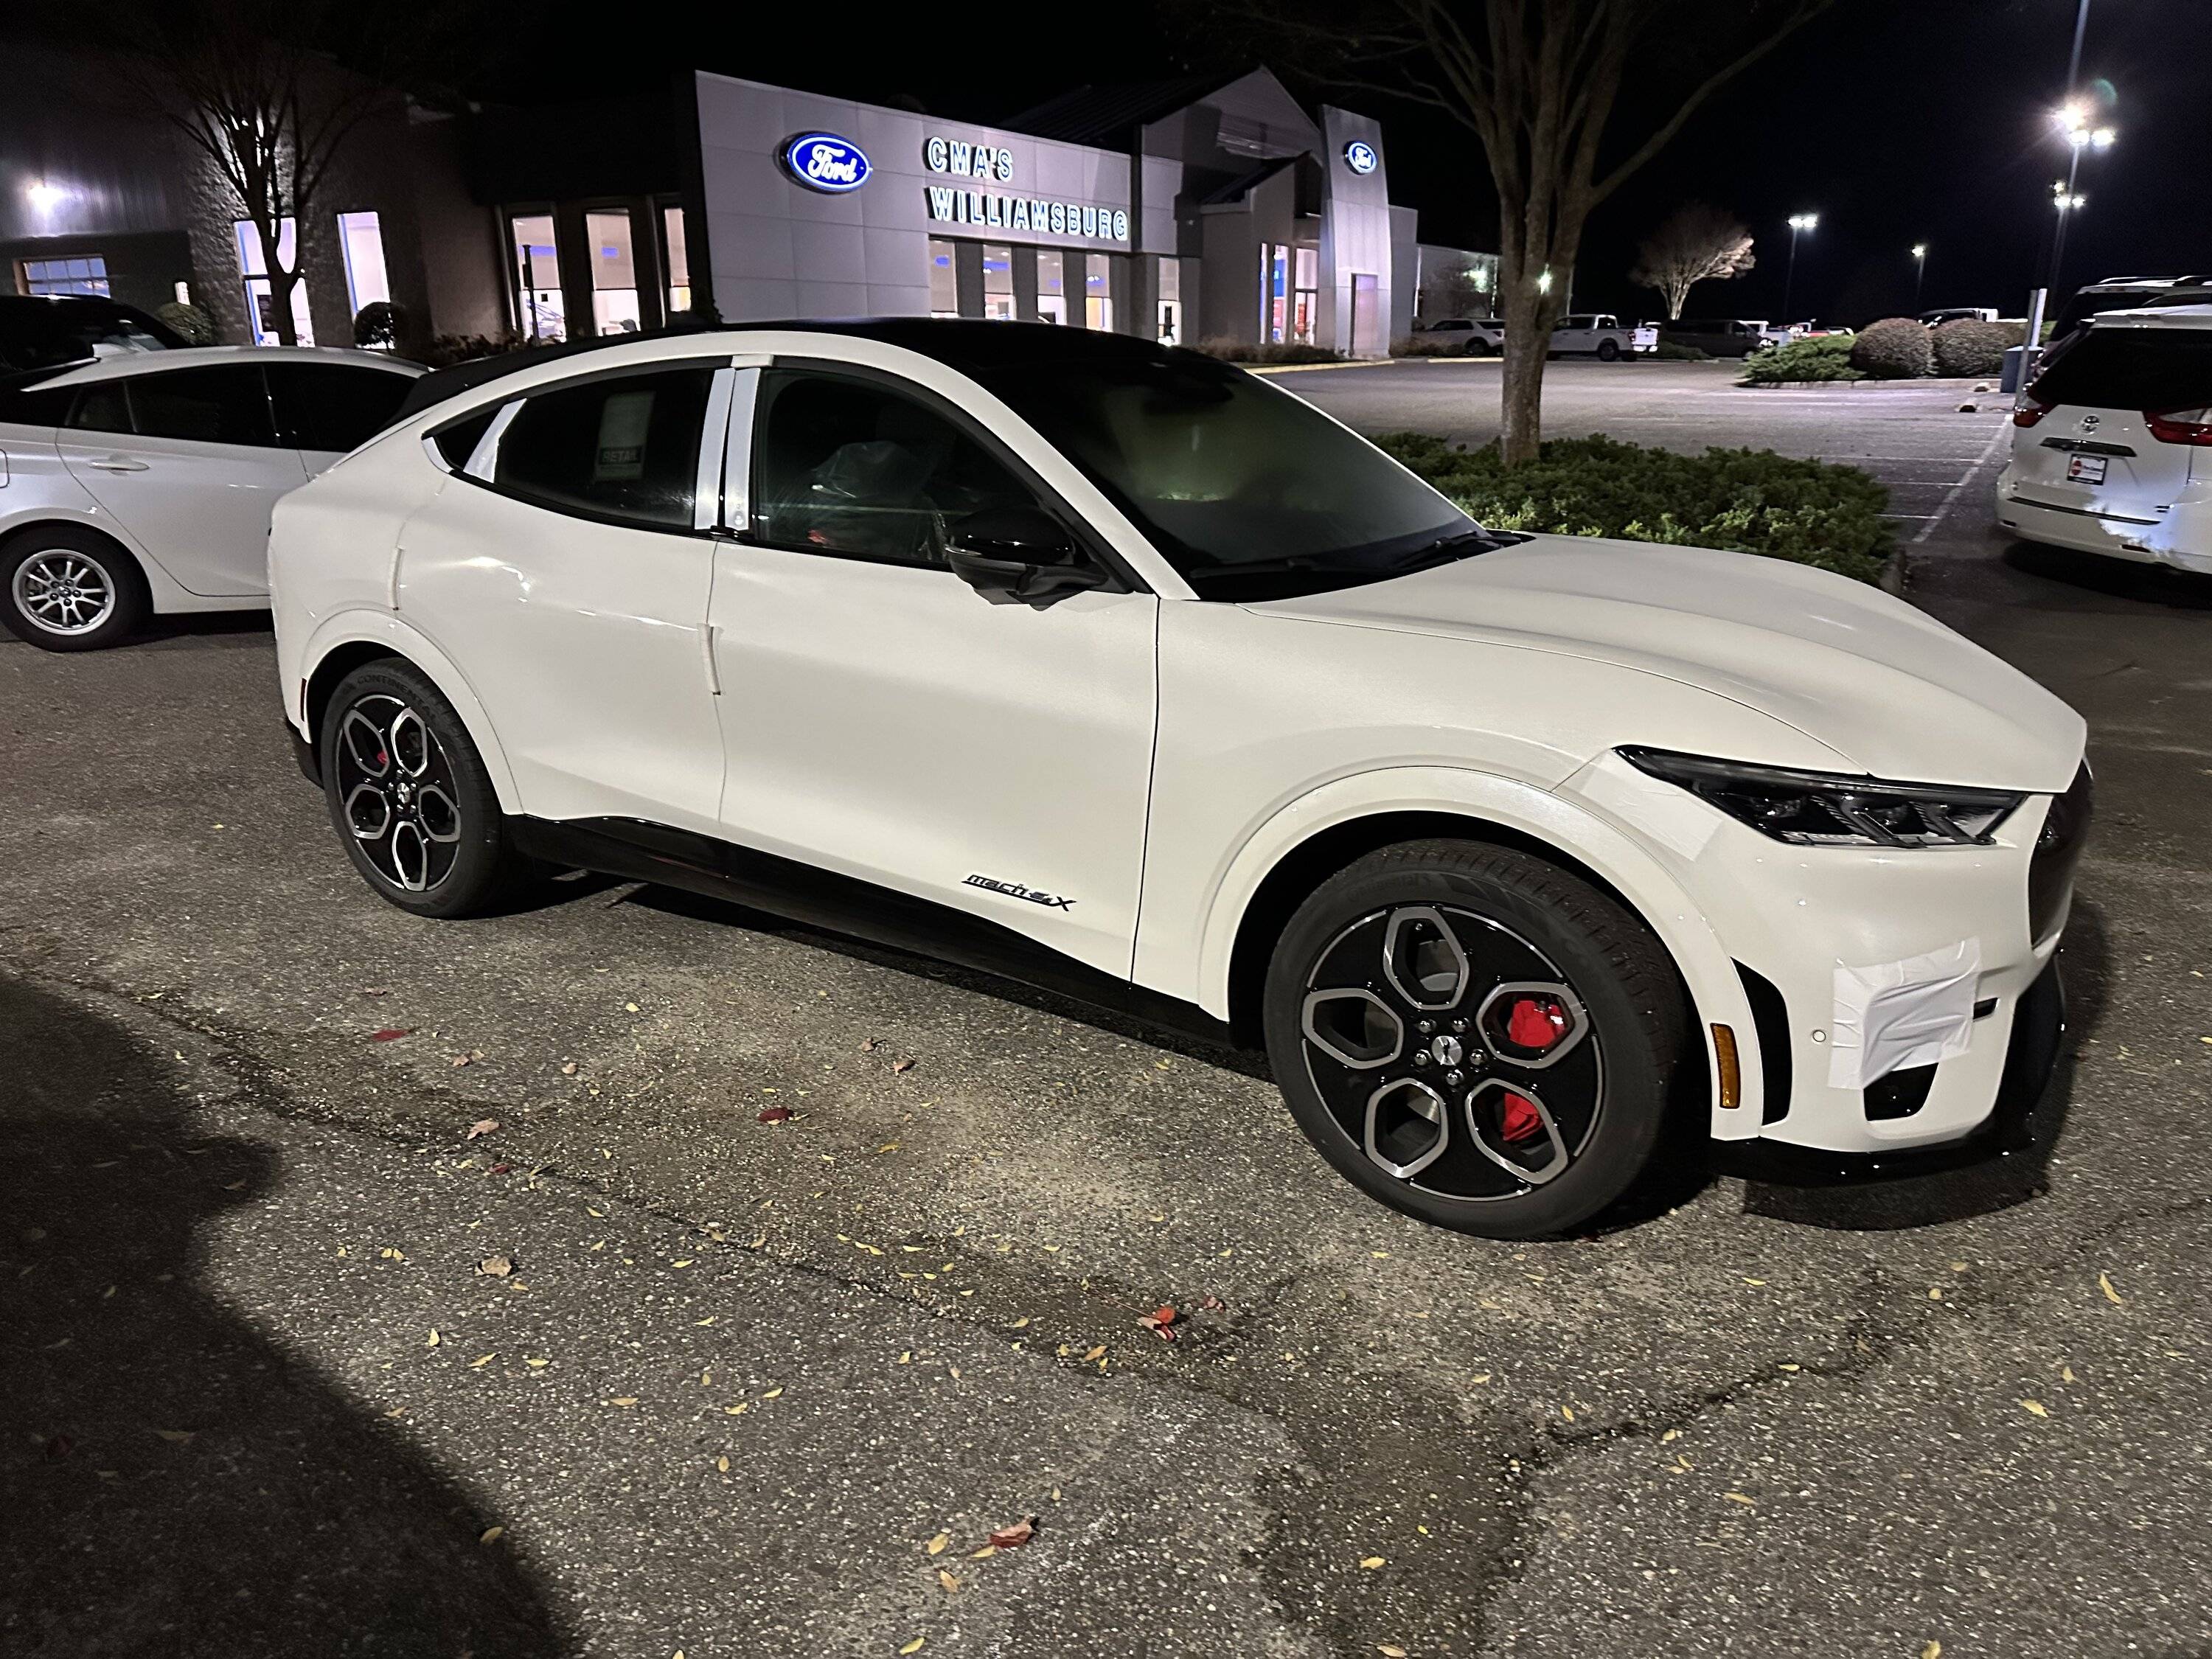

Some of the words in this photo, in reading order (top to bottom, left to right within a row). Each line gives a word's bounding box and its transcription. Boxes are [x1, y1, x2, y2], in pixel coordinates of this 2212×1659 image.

[807, 144, 858, 182] Ford
[928, 136, 1012, 182] CMA'S
[929, 186, 1127, 241] WILLIAMSBURG
